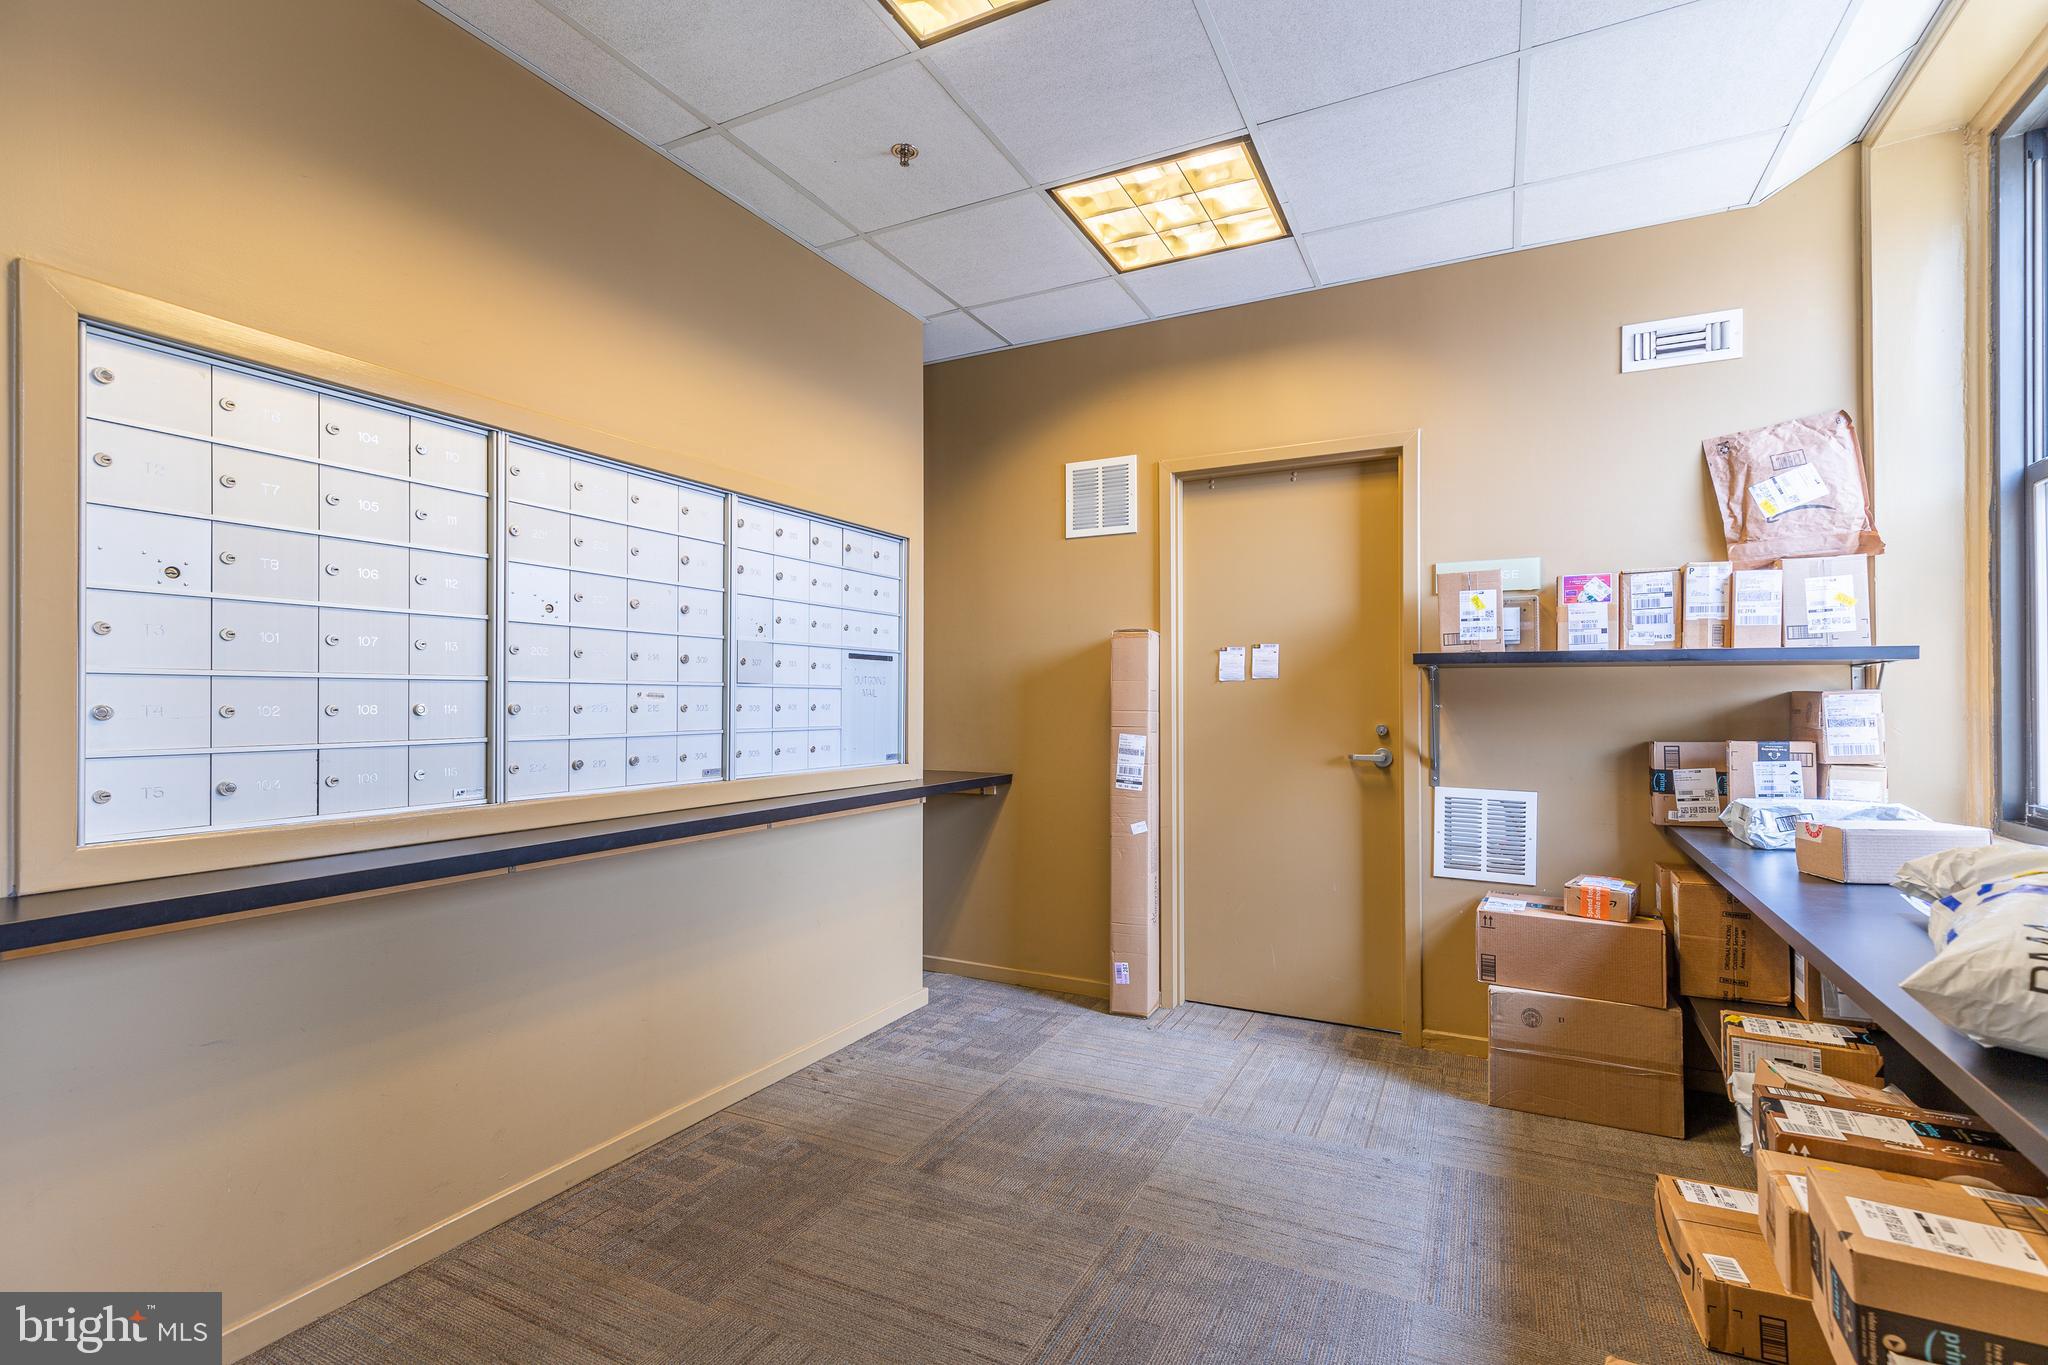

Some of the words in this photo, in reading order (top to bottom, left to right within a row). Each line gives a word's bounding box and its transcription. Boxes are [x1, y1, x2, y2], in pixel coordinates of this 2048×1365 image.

[358, 431, 379, 445] 104
[260, 482, 281, 497] T7
[358, 498, 380, 513] 105
[260, 557, 279, 570] T8
[358, 567, 379, 580] 106
[1689, 567, 1695, 575] P
[445, 577, 459, 589] 112
[258, 631, 280, 644] 101
[357, 636, 379, 648] 107
[257, 705, 281, 717] 102
[357, 704, 378, 716] 108
[444, 704, 459, 715] 114
[1586, 898, 1594, 918] Spend
[1593, 900, 1601, 919] Smile
[1724, 947, 1732, 971] ORIGINAL
